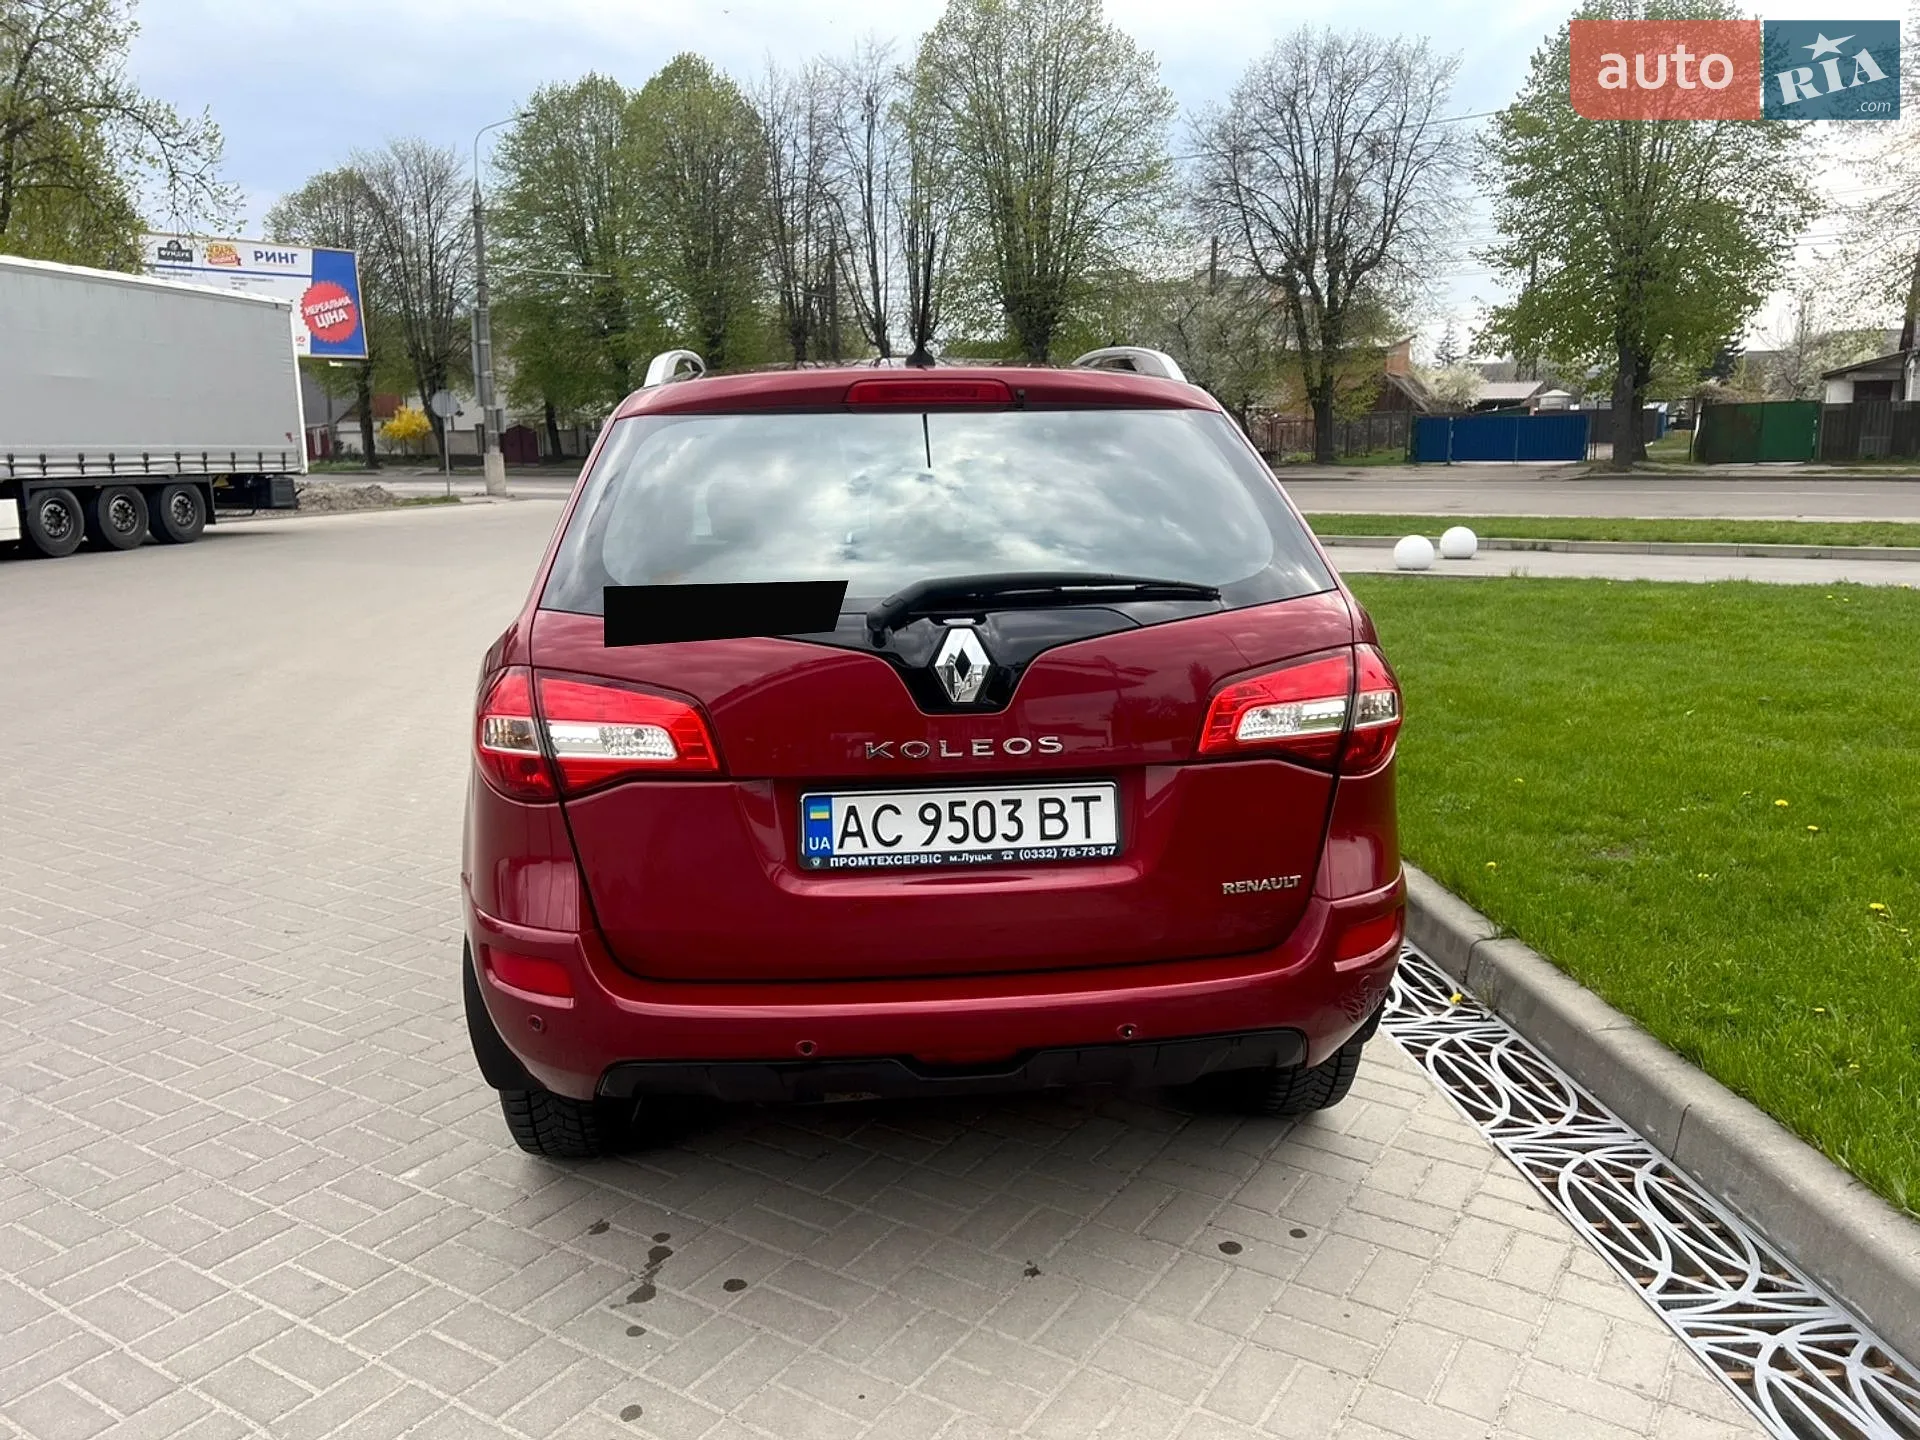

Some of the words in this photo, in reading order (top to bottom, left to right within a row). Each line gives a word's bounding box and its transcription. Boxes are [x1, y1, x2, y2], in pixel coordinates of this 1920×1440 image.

[253, 250, 298, 264] РИНГ
[304, 295, 352, 316] НЕРЕАЛЬНА
[315, 308, 349, 329] ЦІНА
[864, 736, 1064, 759] KOLEOS
[837, 803, 903, 849] AC
[918, 799, 1024, 846] 9503
[1038, 795, 1101, 840] BT
[809, 837, 831, 850] UA
[830, 854, 942, 867] ПРОМТЕХСЕРВІС
[949, 851, 993, 863] м.Луцьк
[1019, 849, 1057, 860] (0332)
[1221, 874, 1302, 895] RENAULT
